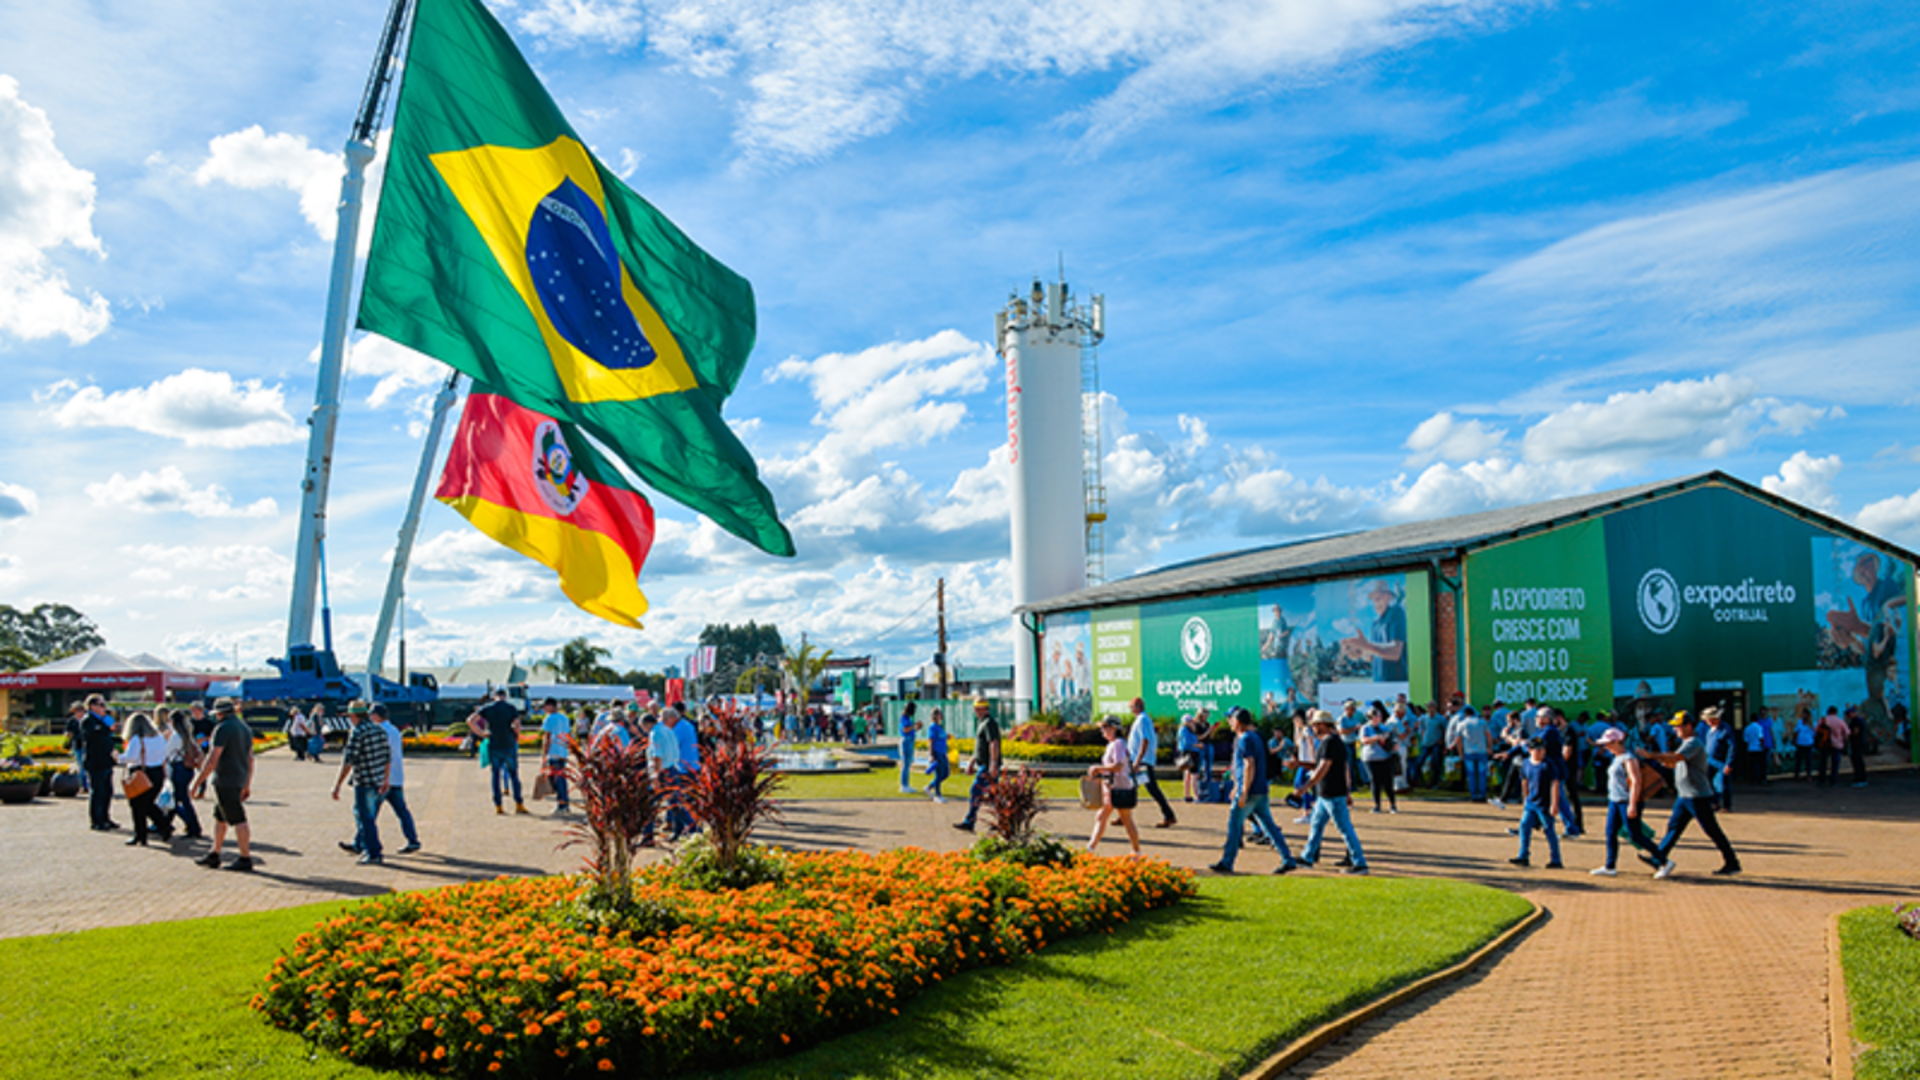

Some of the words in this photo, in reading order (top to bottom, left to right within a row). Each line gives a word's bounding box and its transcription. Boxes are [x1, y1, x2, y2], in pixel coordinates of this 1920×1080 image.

[1490, 587, 1502, 611] A
[1503, 587, 1586, 611] EXPODIRETO
[1684, 578, 1796, 608] expodireto
[1713, 608, 1769, 623] COTRIJAL
[1492, 618, 1546, 643] CRESCE
[1547, 617, 1581, 642] COM
[1493, 649, 1505, 674] O
[1507, 648, 1546, 673] AGRO
[1548, 648, 1557, 672] E
[1557, 647, 1569, 672] O
[1157, 674, 1241, 698] expodireto
[1495, 679, 1534, 704] AGRO
[1536, 678, 1588, 702] CRESCE
